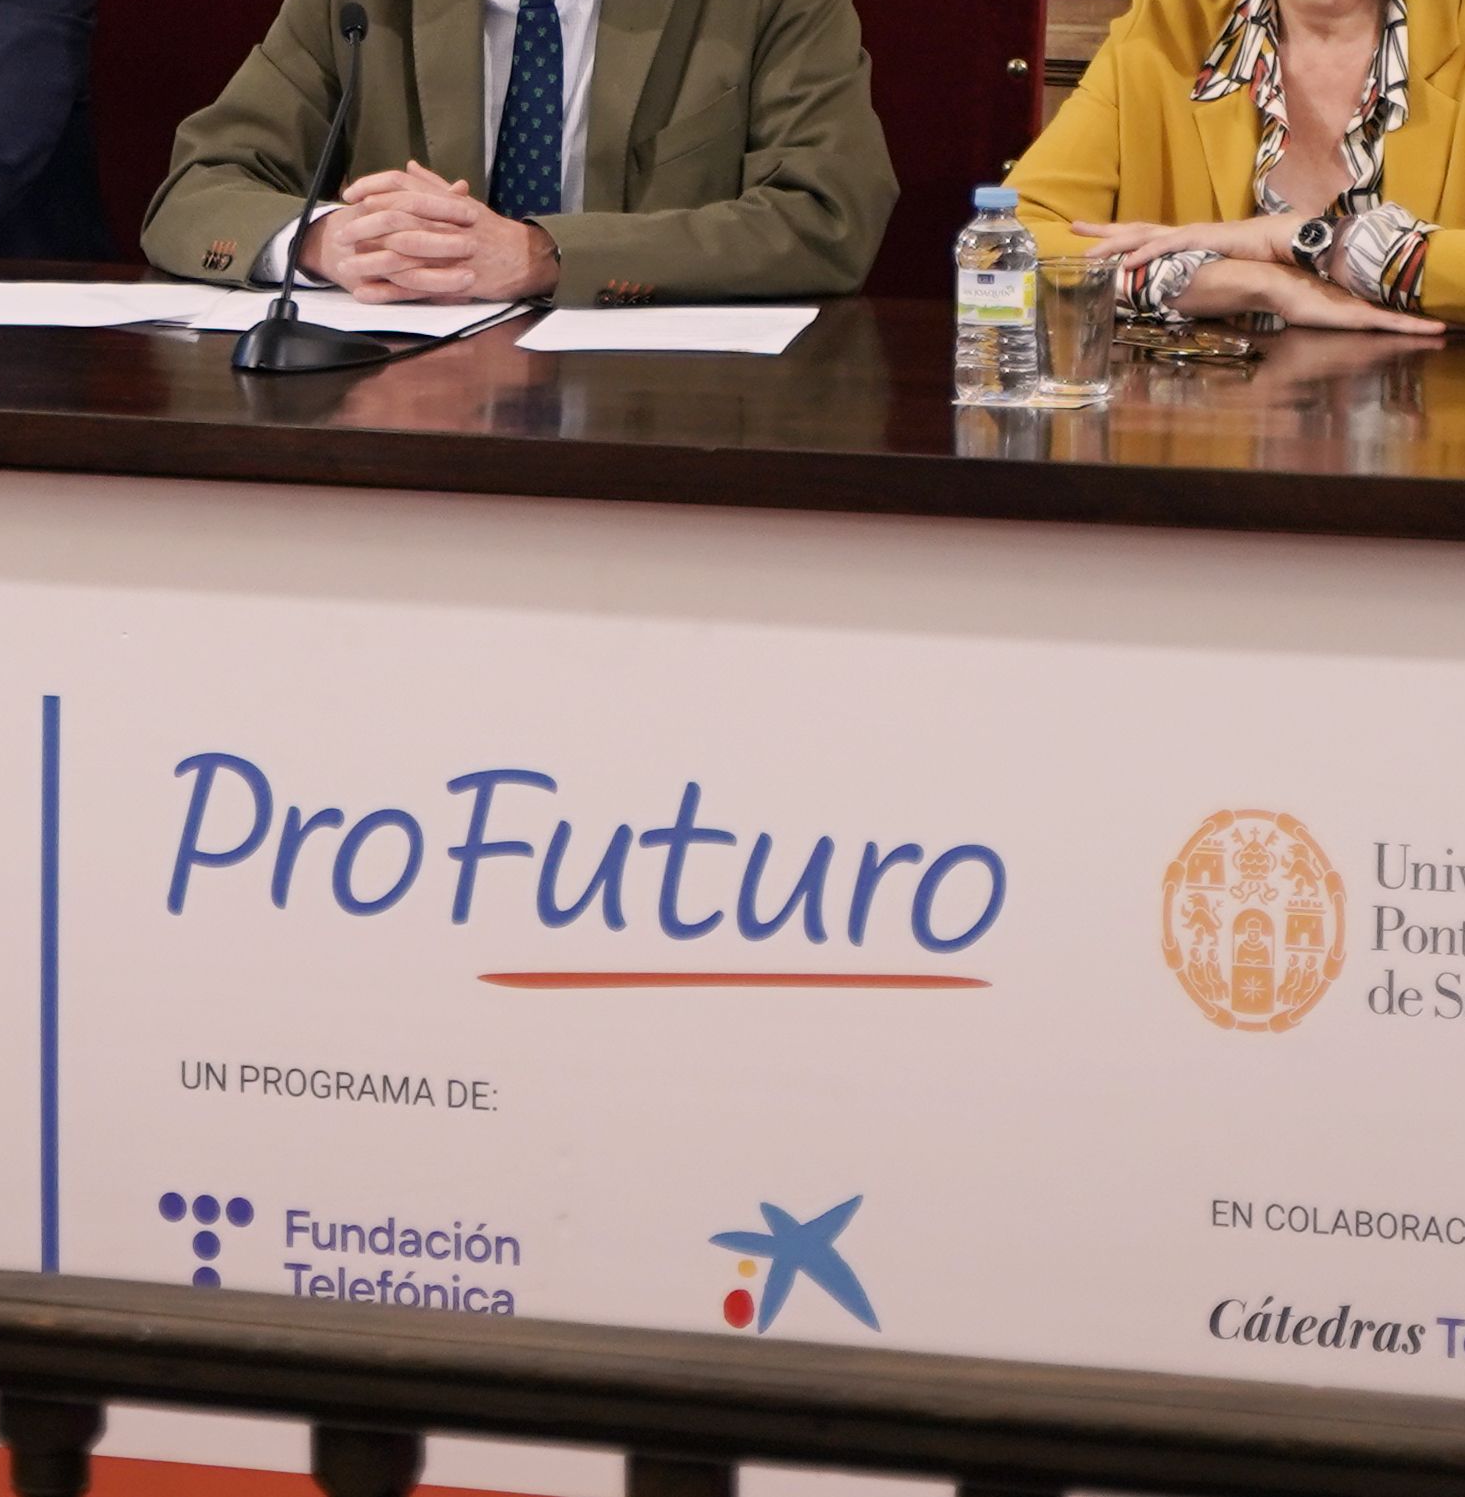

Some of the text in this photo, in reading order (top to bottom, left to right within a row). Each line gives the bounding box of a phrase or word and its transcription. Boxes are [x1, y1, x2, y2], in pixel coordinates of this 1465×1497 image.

[167, 751, 1007, 955] ProFuturo
[1367, 969, 1423, 1018] de
[180, 1060, 499, 1112] UN PROGRAMA DE:
[284, 1209, 521, 1267] Fundación
[1211, 1199, 1253, 1230] EN
[283, 1262, 515, 1317] Telefónica
[1208, 1296, 1427, 1356] Cátedras
